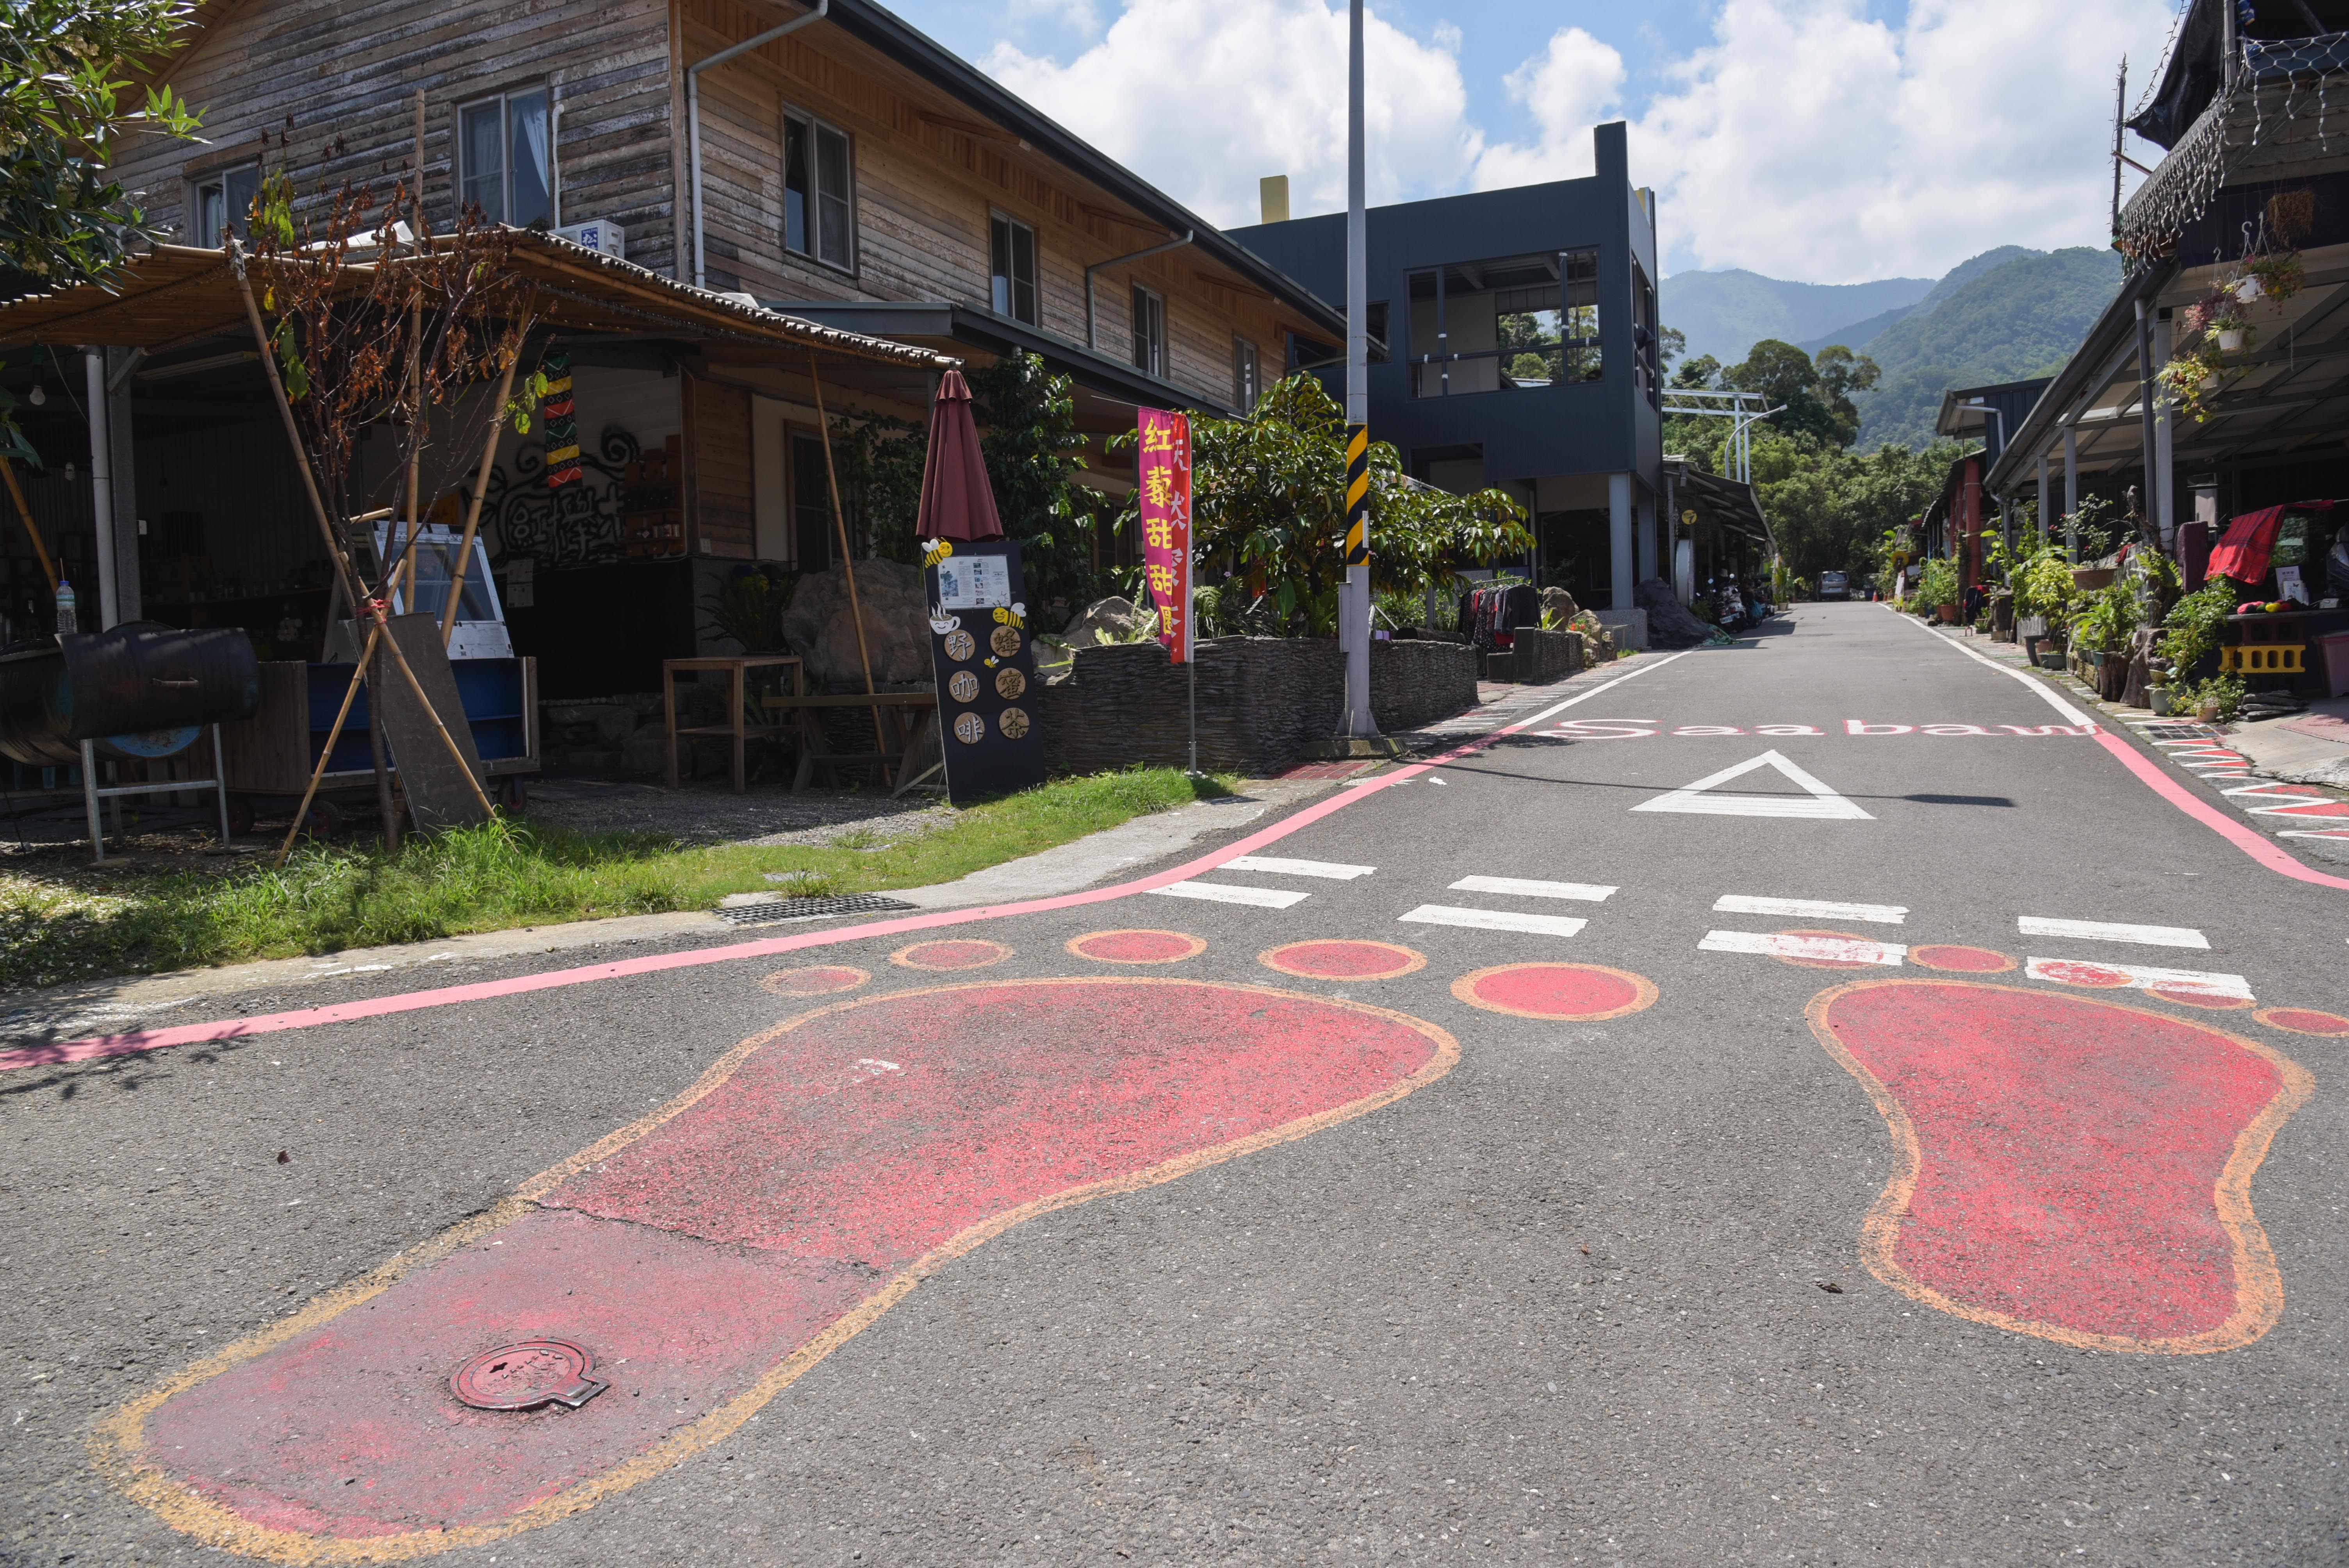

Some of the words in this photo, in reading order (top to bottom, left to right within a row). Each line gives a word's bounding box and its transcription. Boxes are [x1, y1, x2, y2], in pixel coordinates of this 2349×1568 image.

[946, 633, 983, 743] 野咖啡
[993, 629, 1030, 739] 蜂蜜茶
